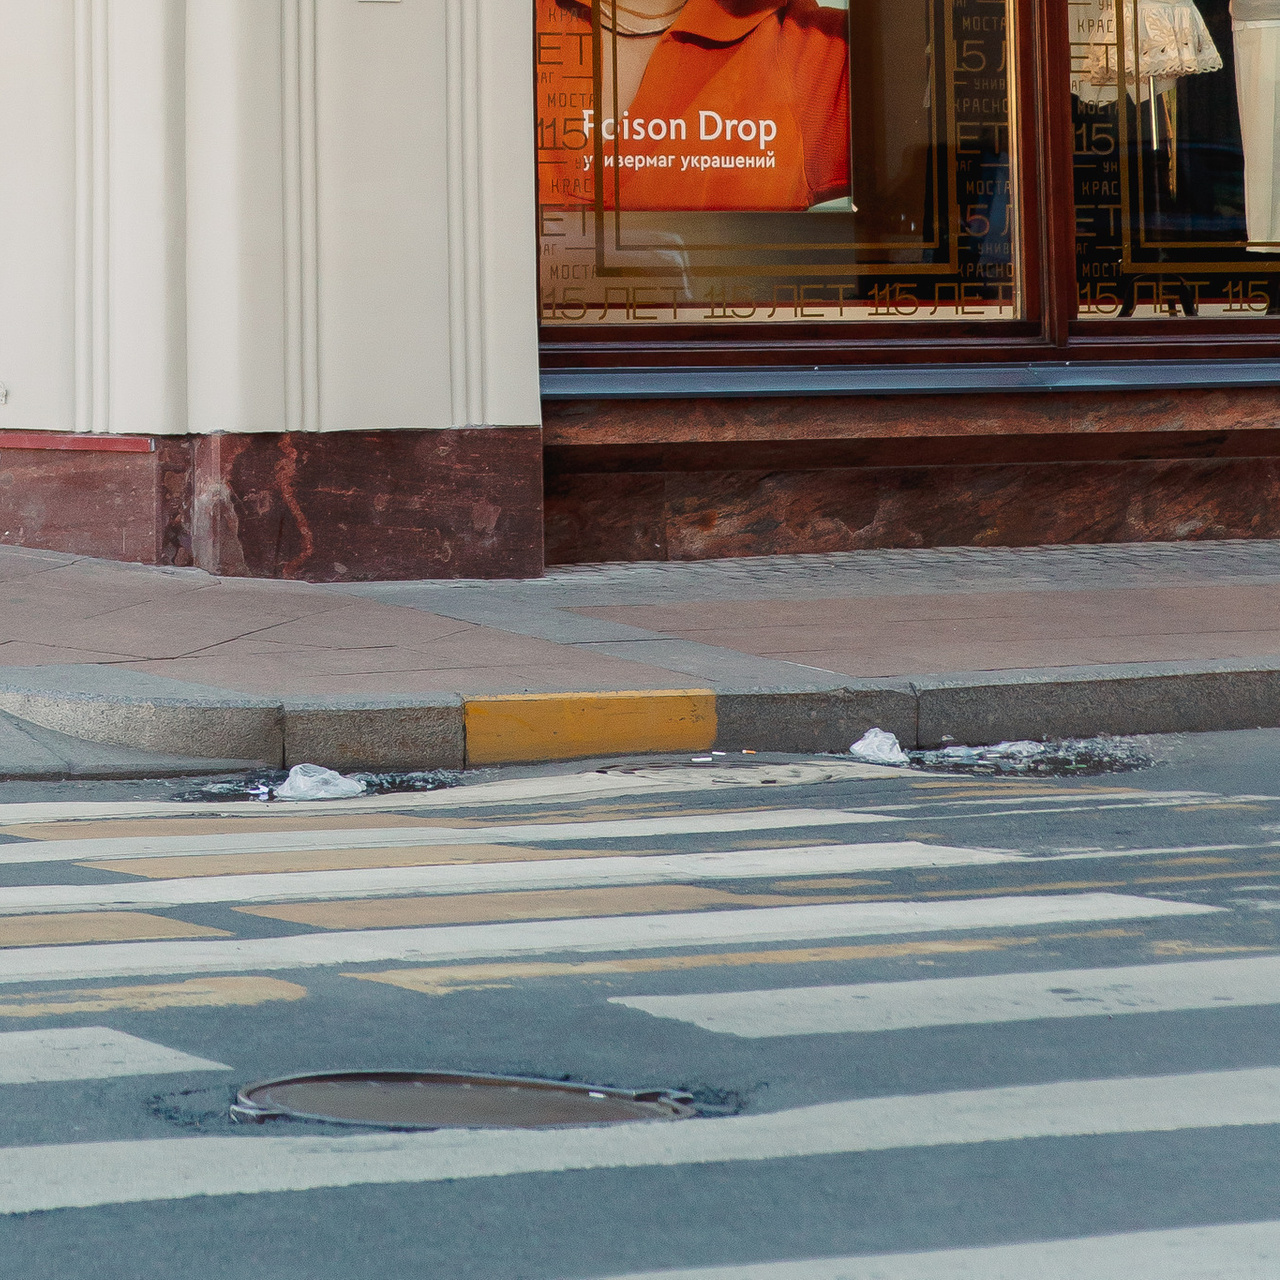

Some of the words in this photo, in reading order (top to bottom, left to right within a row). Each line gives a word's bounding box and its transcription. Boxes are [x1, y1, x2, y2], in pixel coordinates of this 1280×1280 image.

[698, 109, 778, 150] Drop
[582, 152, 676, 172] уивермаг
[680, 149, 776, 172] украшений
[598, 285, 687, 321] ЛЕТ
[767, 283, 856, 319] ЛЕТ
[867, 281, 919, 316] 115
[929, 281, 1015, 316] ЛЕТ
[1128, 280, 1211, 315] ЛЕТ
[1221, 279, 1271, 313] 115
